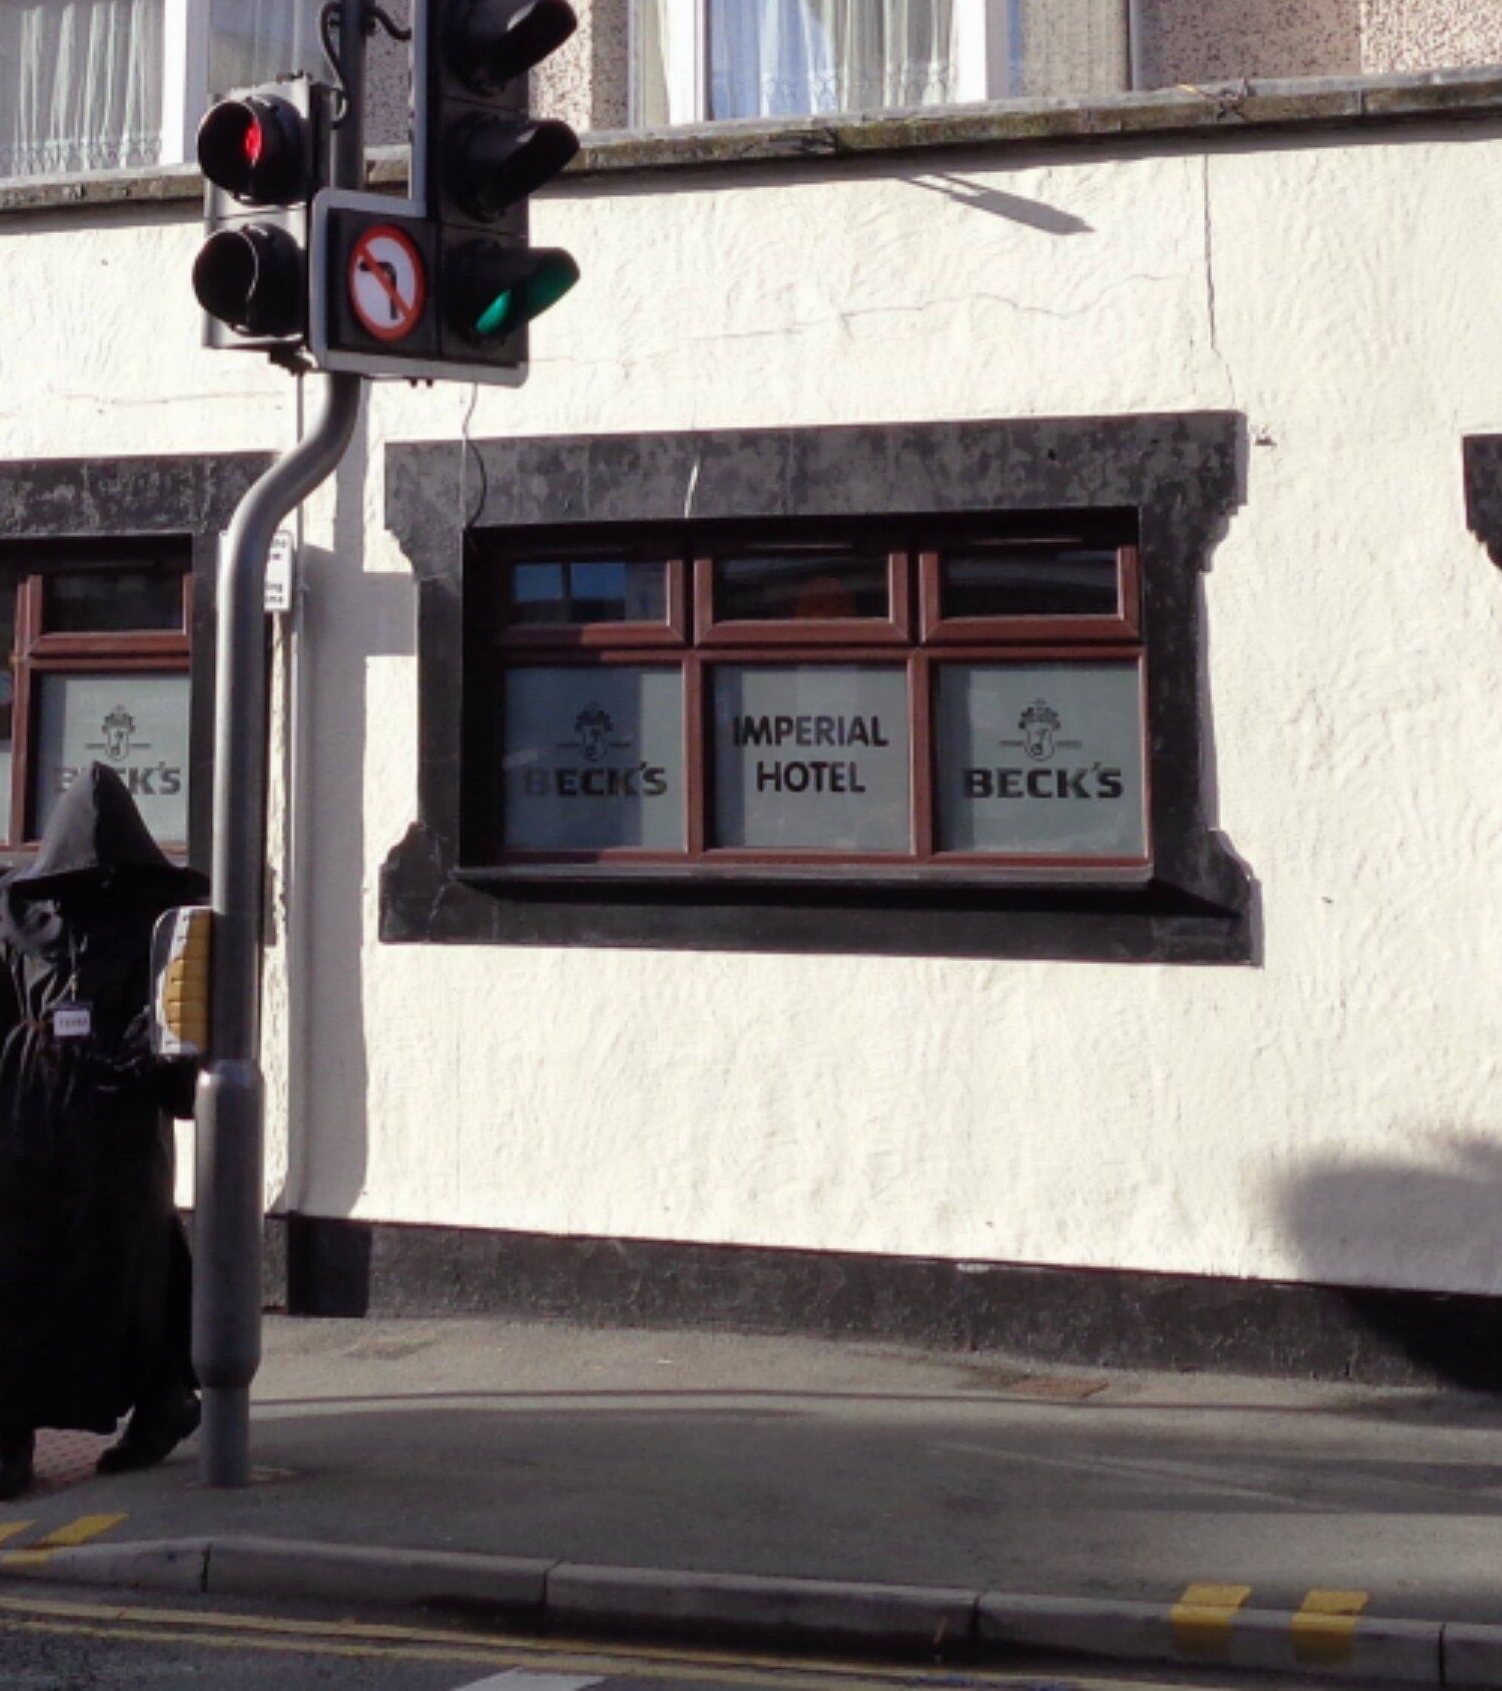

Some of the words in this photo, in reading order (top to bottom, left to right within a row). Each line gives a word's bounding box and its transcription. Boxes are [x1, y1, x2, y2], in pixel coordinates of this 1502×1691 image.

[732, 715, 889, 748] IMPERIAL
[756, 761, 866, 794] HOTEL
[964, 760, 1124, 799] BECK'S
